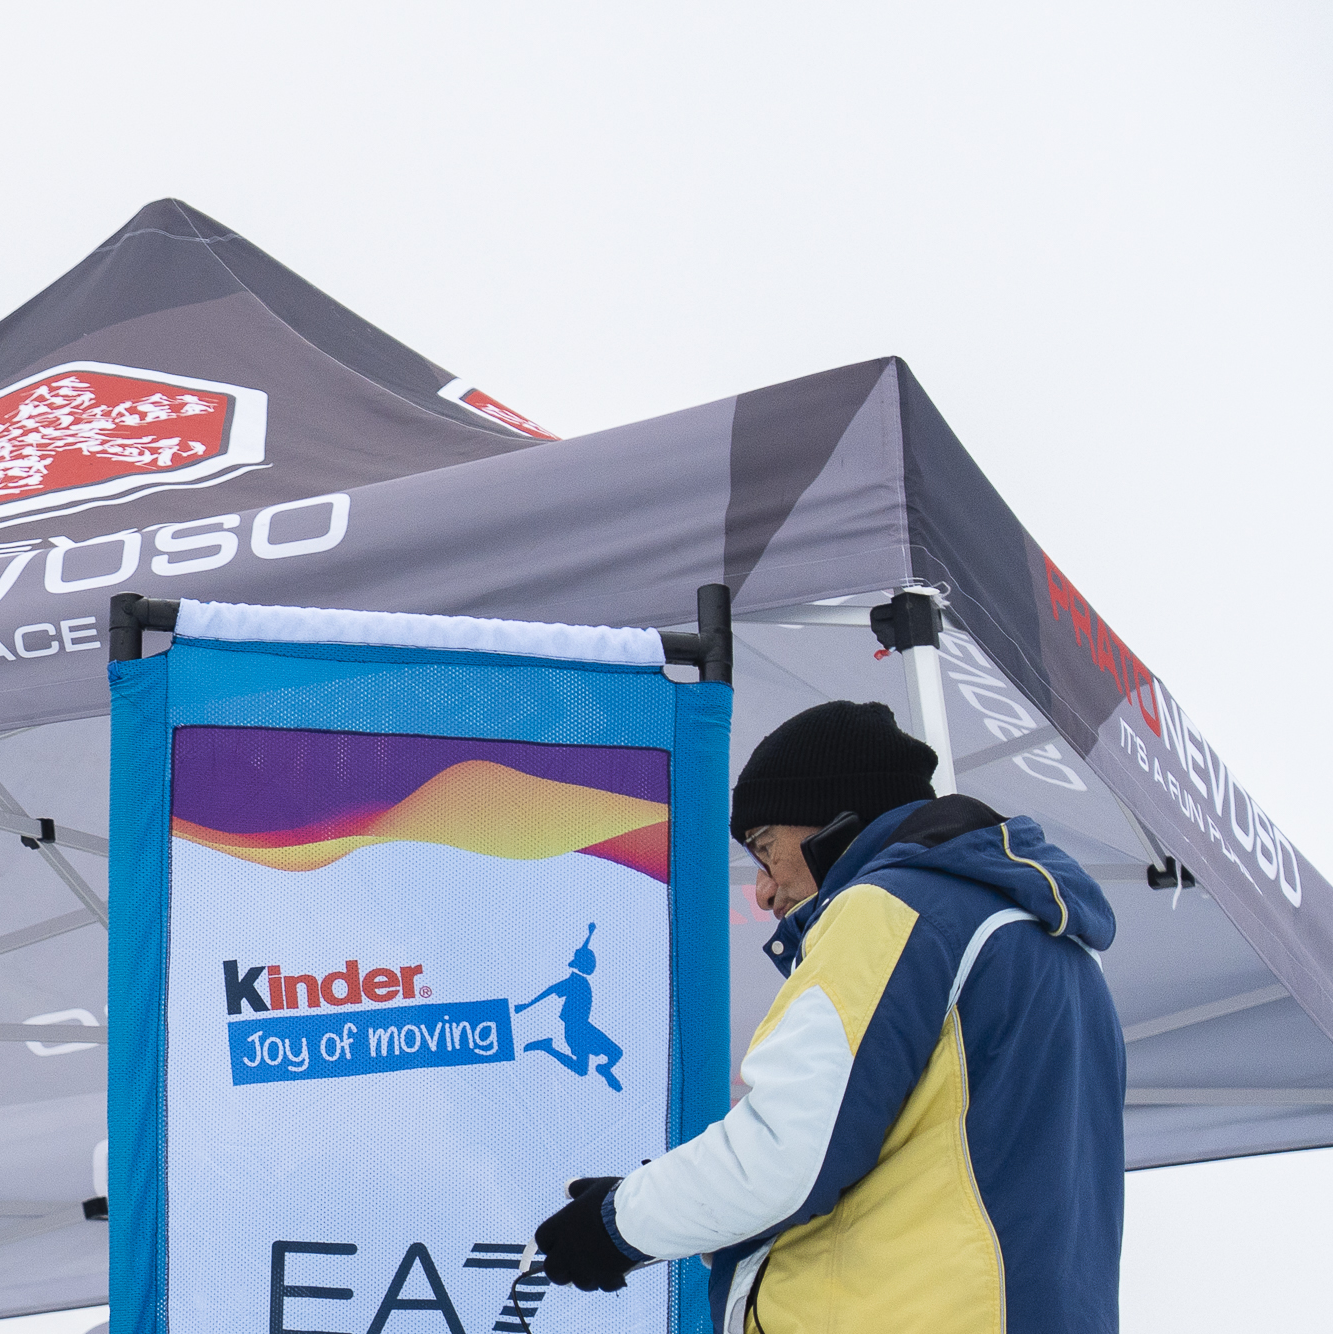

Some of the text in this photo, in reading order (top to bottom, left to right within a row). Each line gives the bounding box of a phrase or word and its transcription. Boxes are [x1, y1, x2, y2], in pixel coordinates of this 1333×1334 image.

[1119, 716, 1150, 773] IT'S
[1153, 756, 1168, 792] A
[1167, 770, 1206, 833] FUN
[242, 1014, 500, 1072] Joy of moving
